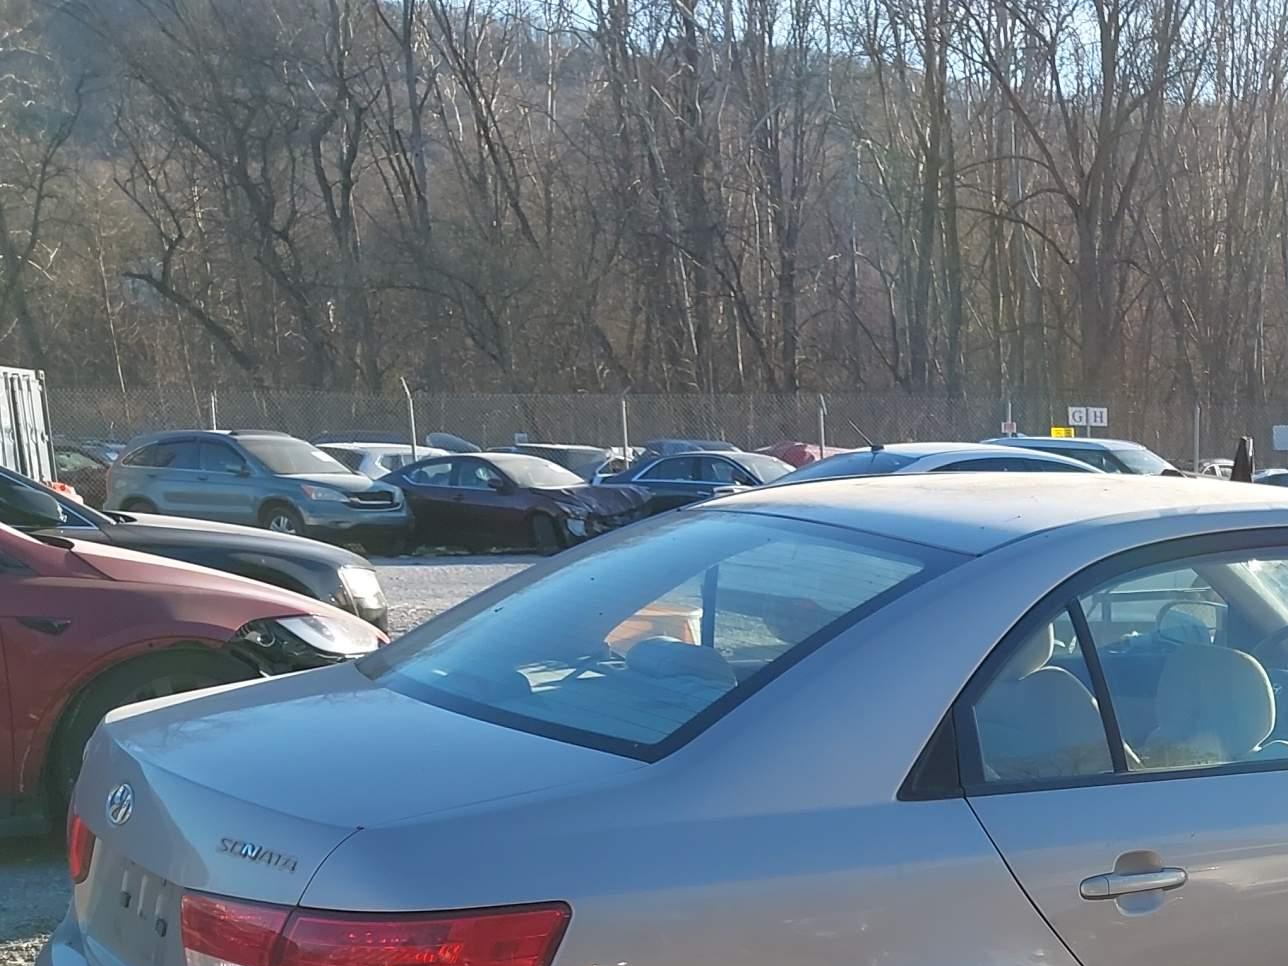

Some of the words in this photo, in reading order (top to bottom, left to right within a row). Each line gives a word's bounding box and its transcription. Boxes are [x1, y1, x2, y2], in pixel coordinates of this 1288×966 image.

[1072, 410, 1083, 423] G
[1093, 410, 1104, 424] H
[219, 837, 298, 872] SONATA
